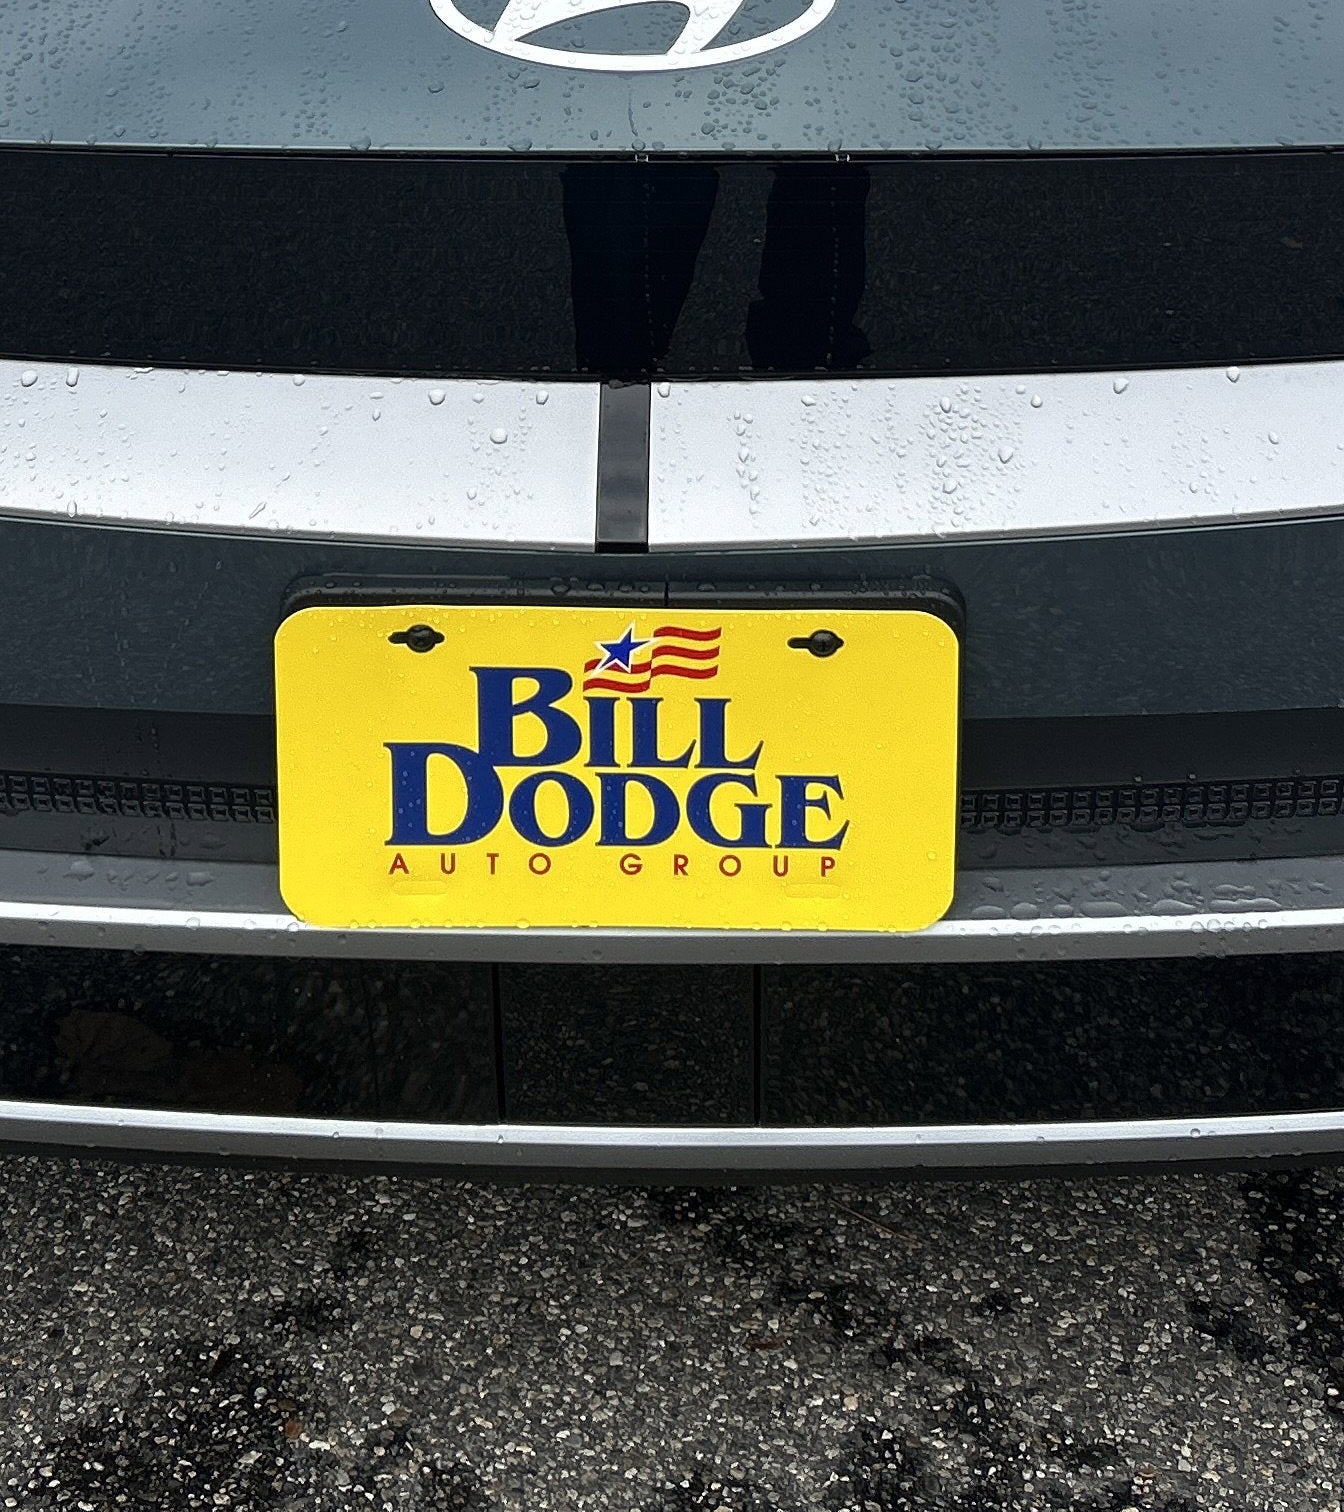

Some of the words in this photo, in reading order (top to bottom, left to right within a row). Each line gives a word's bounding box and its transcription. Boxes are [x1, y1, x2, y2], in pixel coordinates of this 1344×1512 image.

[469, 666, 766, 770] BILL
[383, 741, 851, 851] DODGE
[389, 852, 553, 876] AUTO
[619, 853, 837, 878] GROUP
